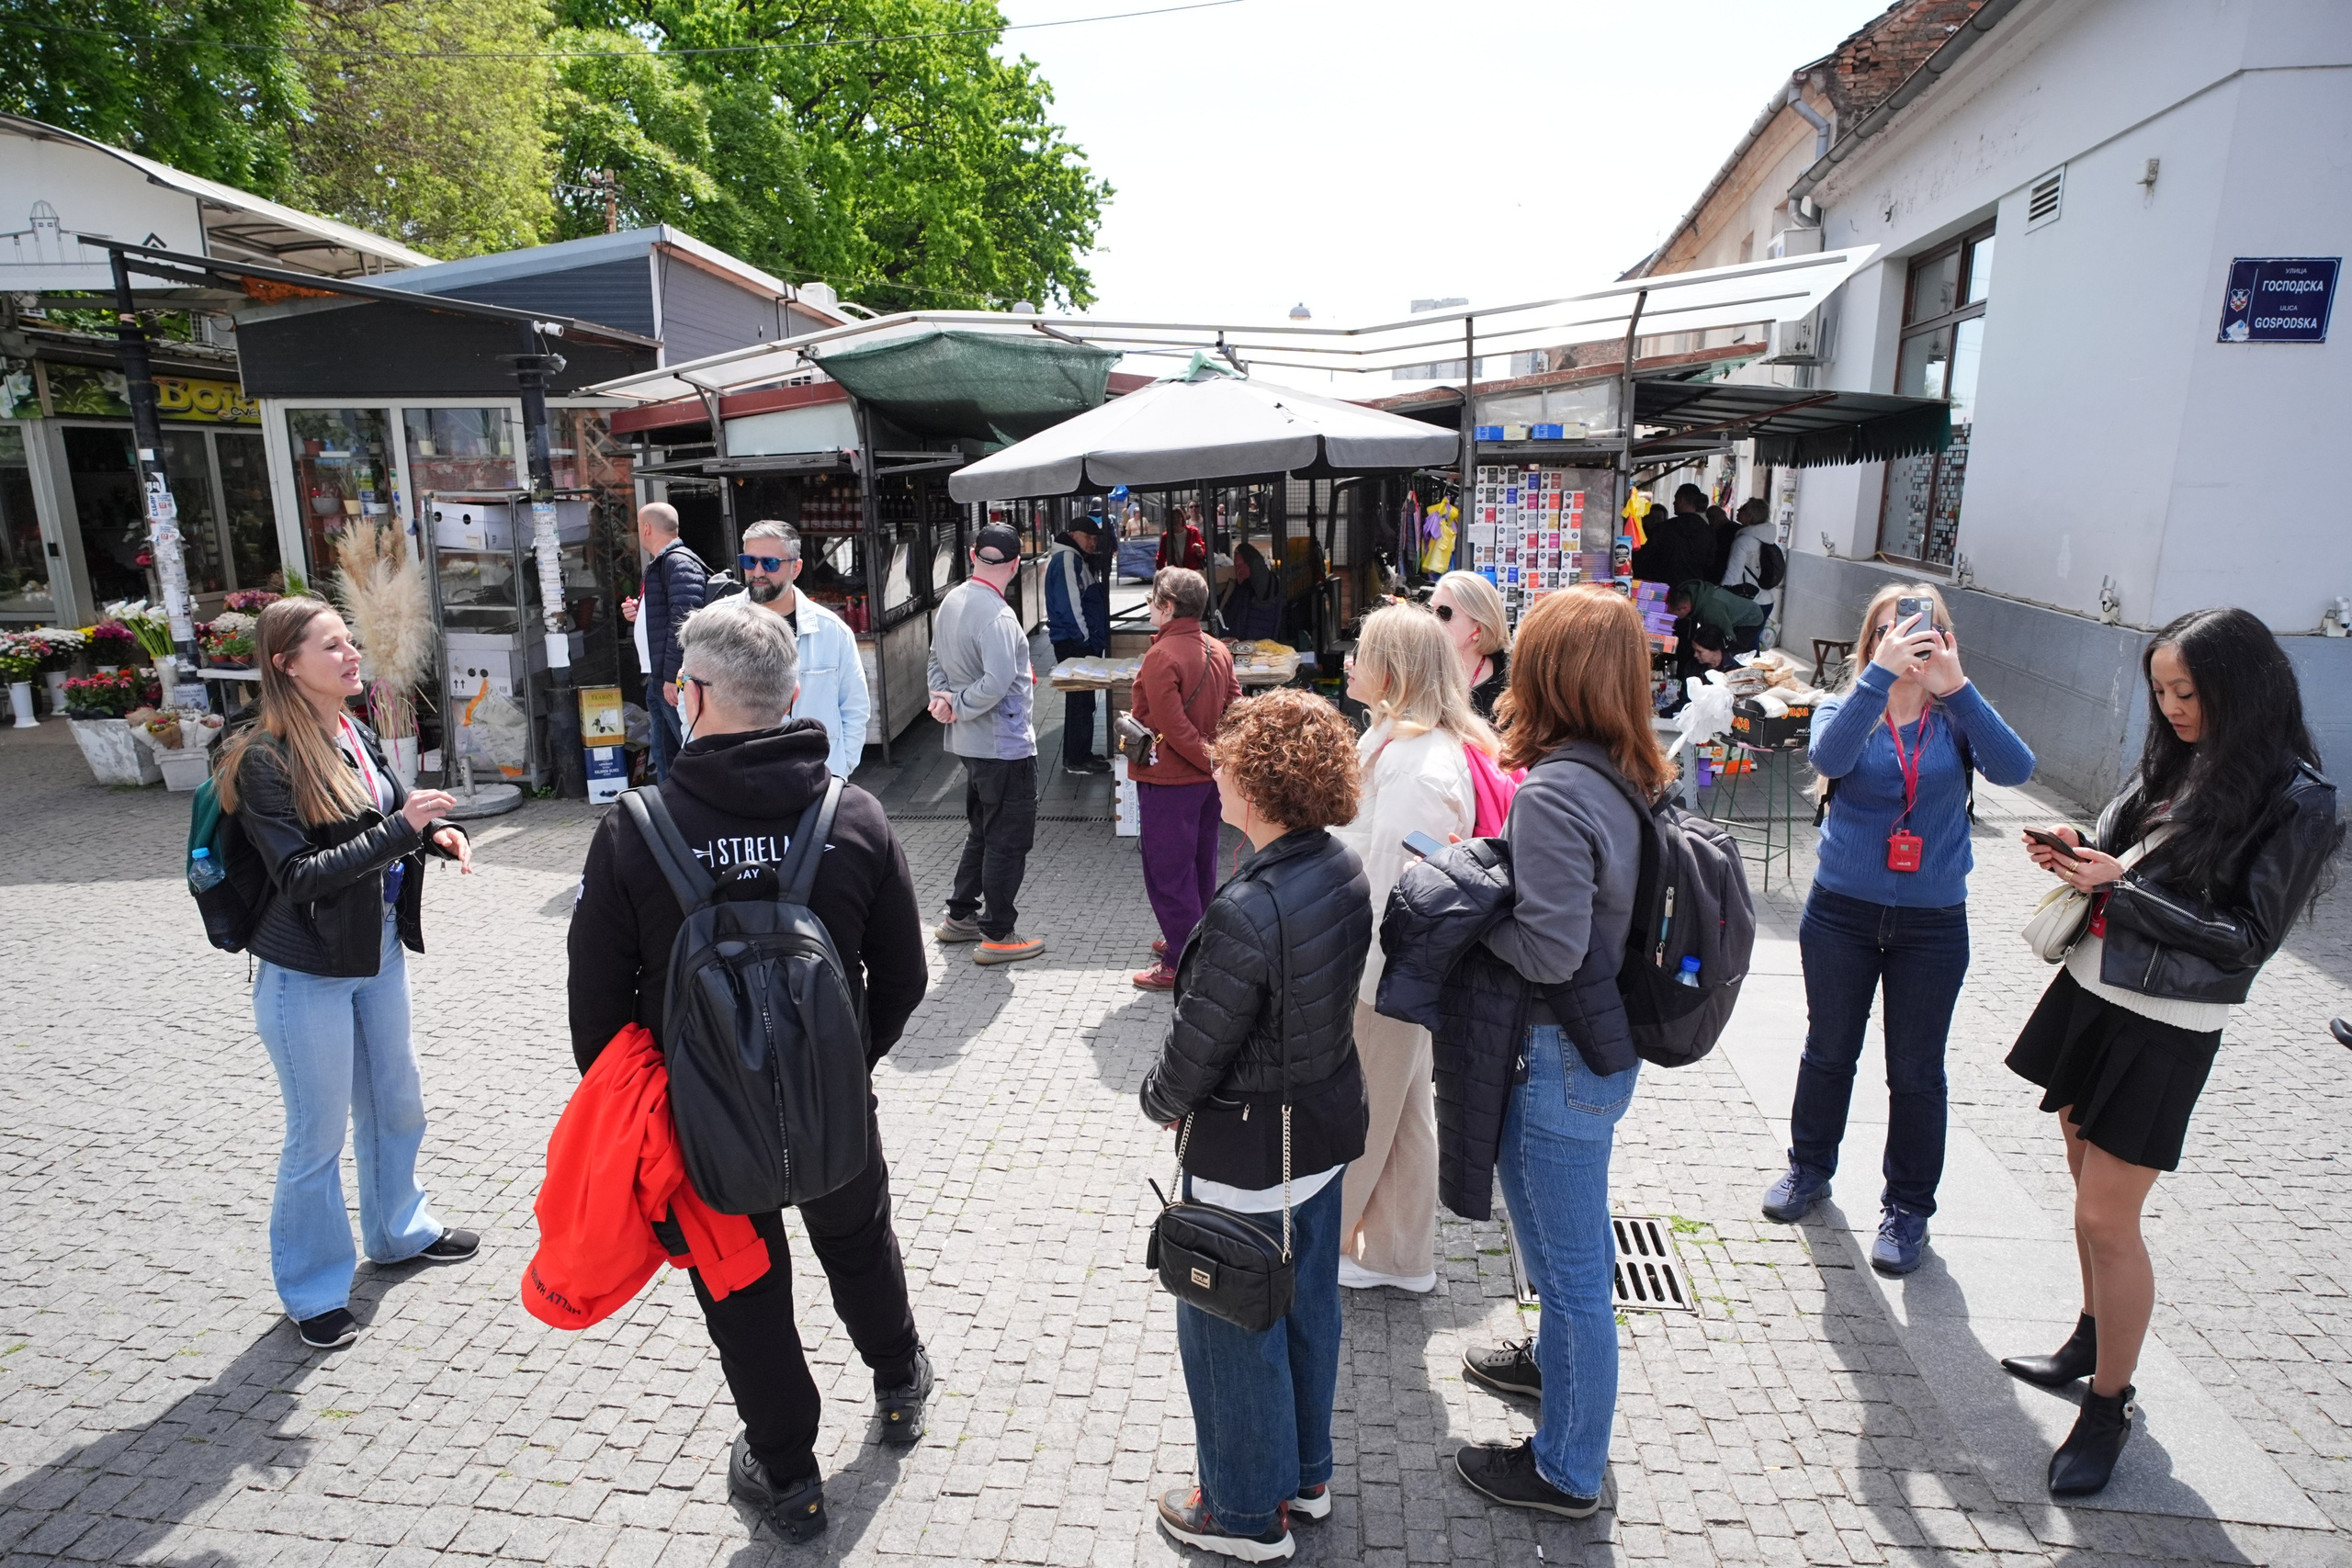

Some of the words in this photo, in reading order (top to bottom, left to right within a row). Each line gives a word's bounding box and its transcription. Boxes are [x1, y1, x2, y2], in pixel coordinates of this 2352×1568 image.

[2262, 280, 2324, 294] ГОСПОДСКА
[2255, 317, 2317, 329] GOSPODSKA
[545, 1292, 582, 1315] HELLY
